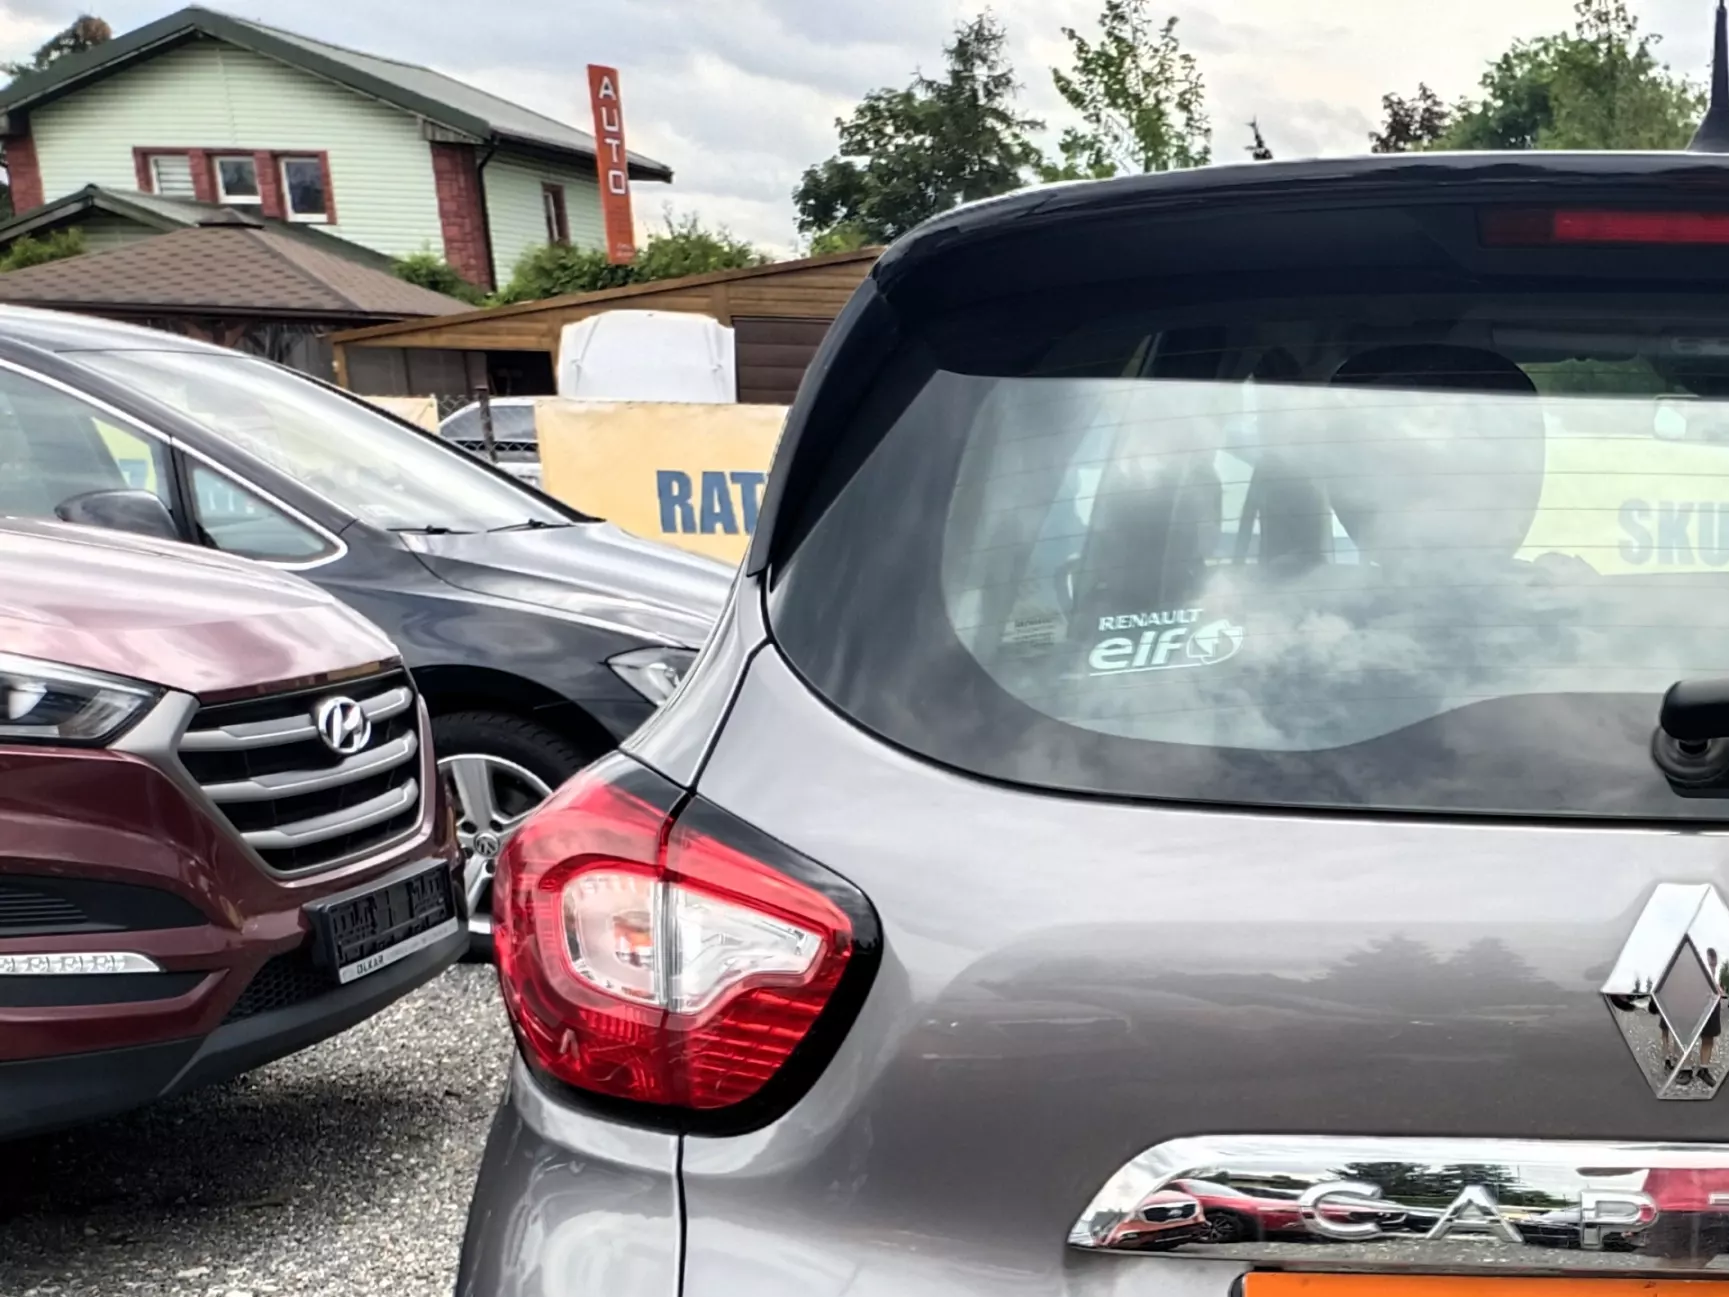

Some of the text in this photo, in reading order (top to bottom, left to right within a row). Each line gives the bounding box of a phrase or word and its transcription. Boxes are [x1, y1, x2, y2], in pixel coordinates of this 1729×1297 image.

[598, 75, 626, 195] AUTO
[1099, 608, 1204, 631] RENAULT
[1089, 627, 1187, 669] elf
